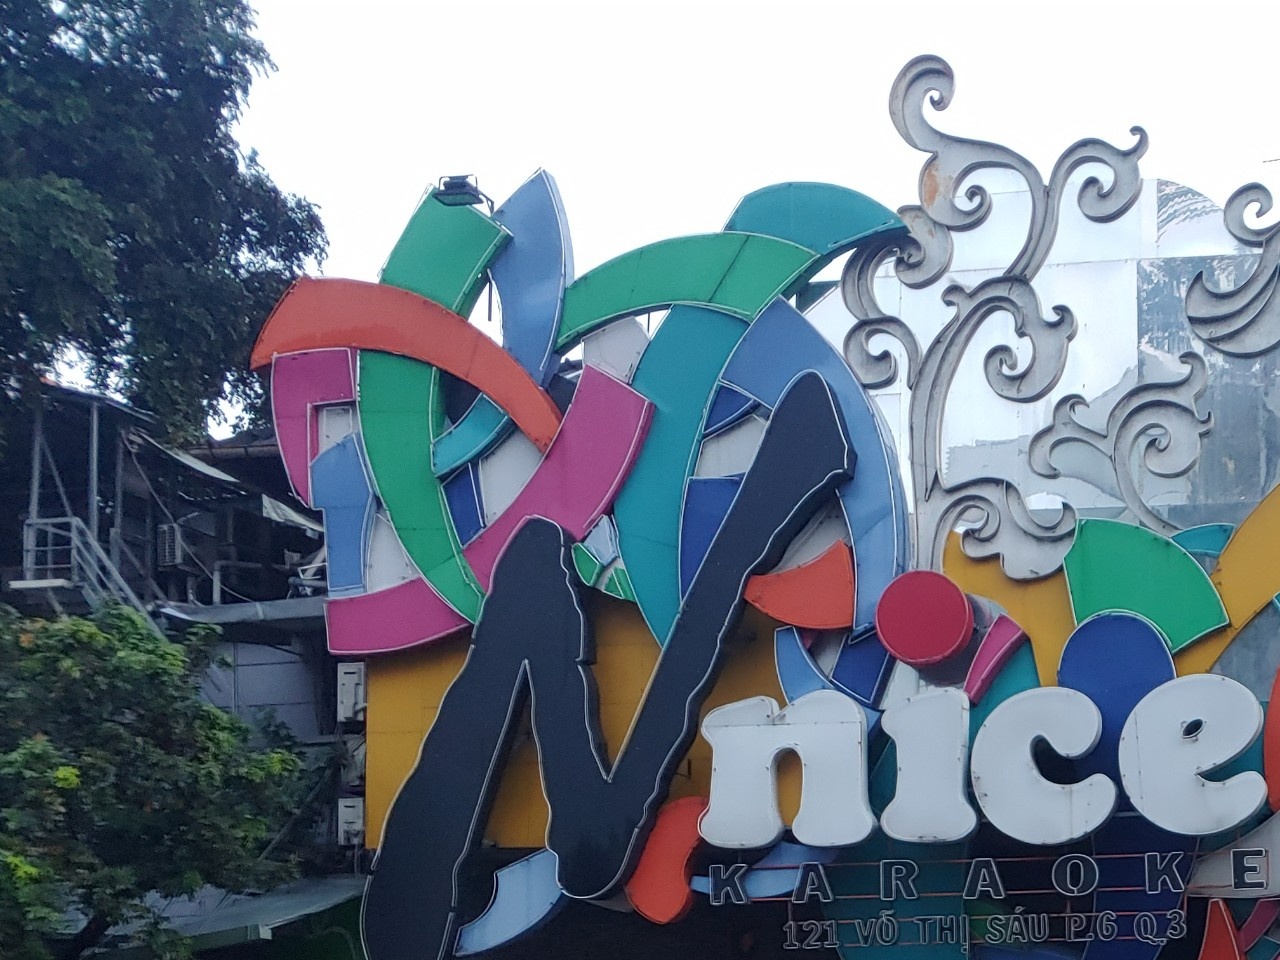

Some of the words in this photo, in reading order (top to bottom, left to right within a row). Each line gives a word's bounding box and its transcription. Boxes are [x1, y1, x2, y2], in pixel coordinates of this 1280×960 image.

[698, 571, 1268, 848] nice
[708, 848, 1266, 905] KARAOKE
[782, 919, 840, 950] 121
[853, 909, 899, 947] VÕ
[914, 914, 970, 953] THỊ
[985, 906, 1050, 944] SÁU
[1065, 914, 1118, 943] P.6
[1134, 909, 1188, 946] Q.3
